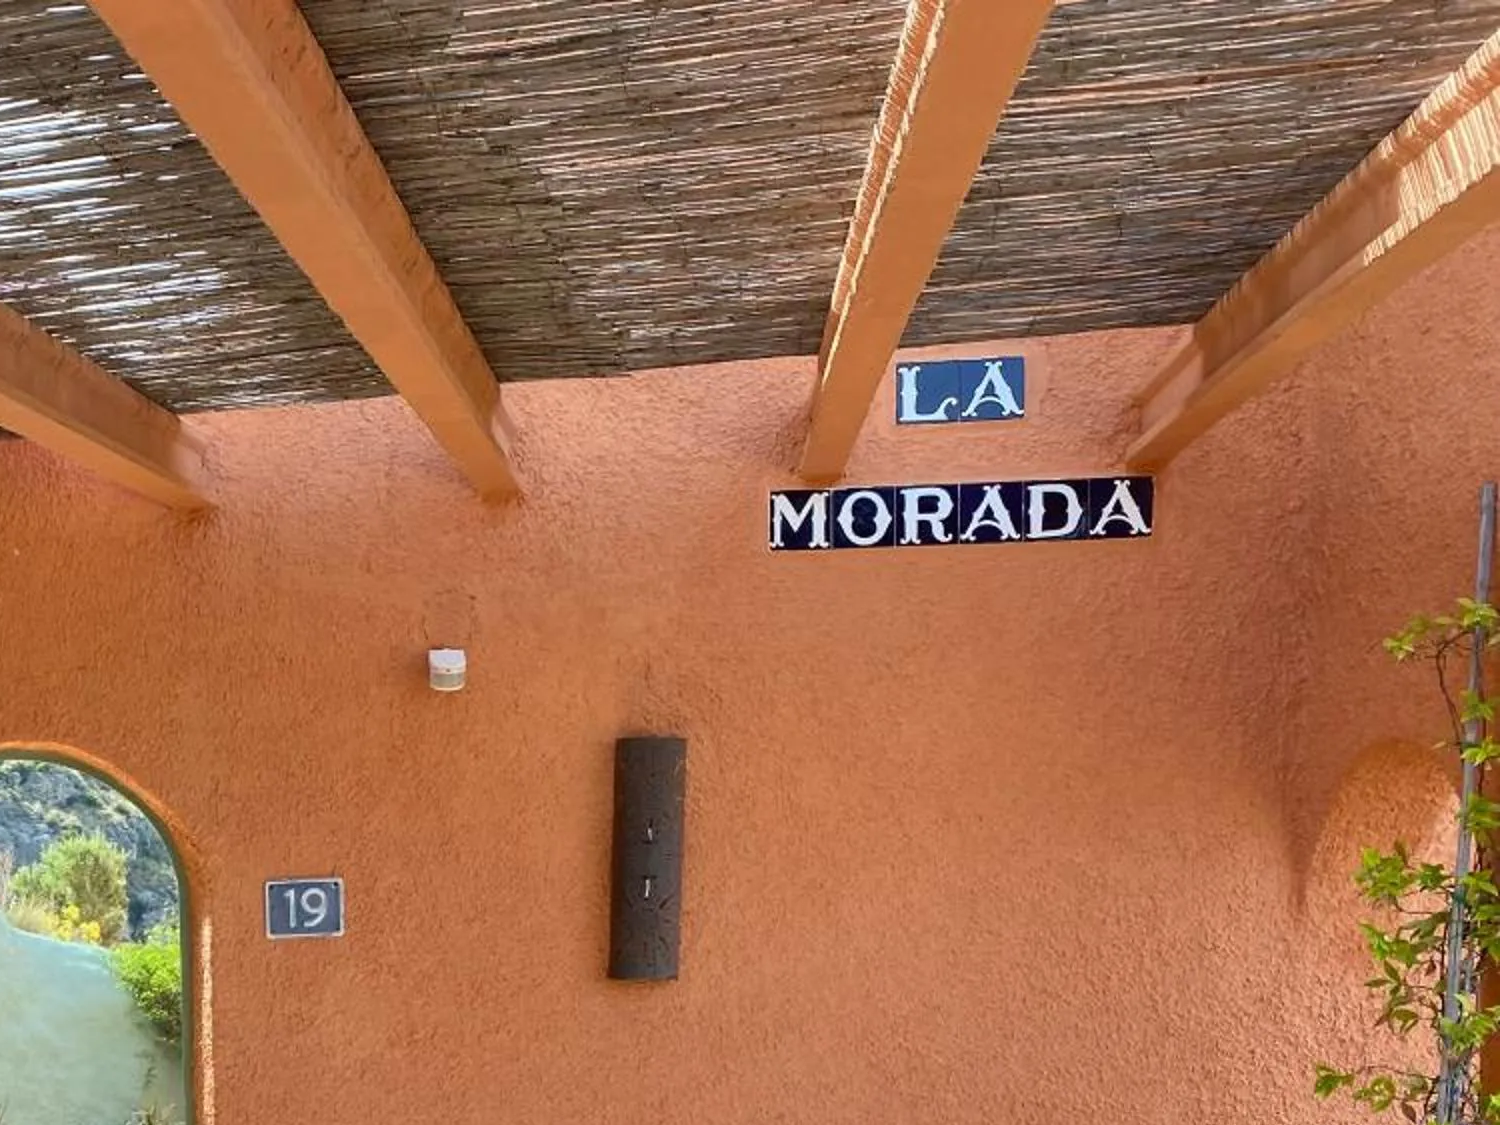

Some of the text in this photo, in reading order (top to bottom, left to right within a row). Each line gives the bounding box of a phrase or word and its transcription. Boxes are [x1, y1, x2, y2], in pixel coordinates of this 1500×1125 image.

[898, 361, 1024, 421] LA
[770, 479, 1151, 548] MORADA
[283, 887, 327, 928] 19
